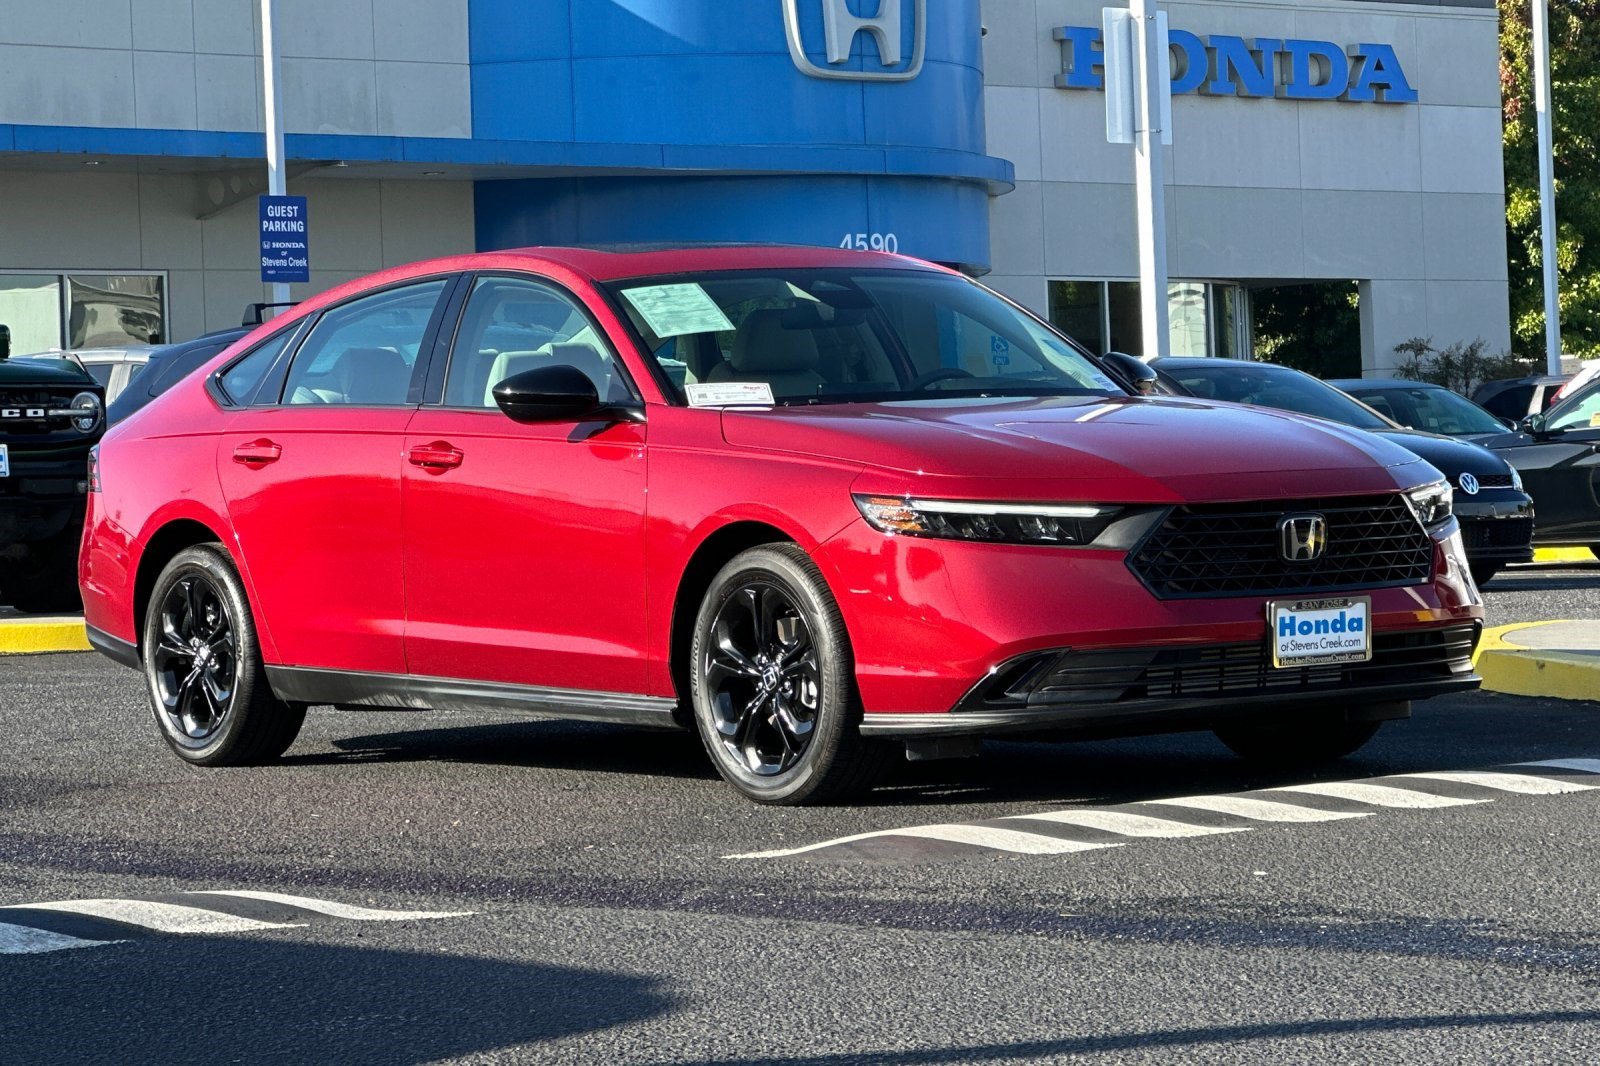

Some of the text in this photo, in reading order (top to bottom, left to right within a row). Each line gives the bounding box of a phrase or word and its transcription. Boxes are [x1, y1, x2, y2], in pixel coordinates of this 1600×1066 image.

[267, 205, 299, 218] GUEST
[262, 220, 305, 233] PARKING
[840, 232, 898, 254] 4590
[262, 257, 307, 267] Stevens Creek
[1301, 600, 1344, 610] SAN JOSE
[1279, 611, 1363, 637] Honda
[1280, 636, 1361, 652] of Stevens Creek.com
